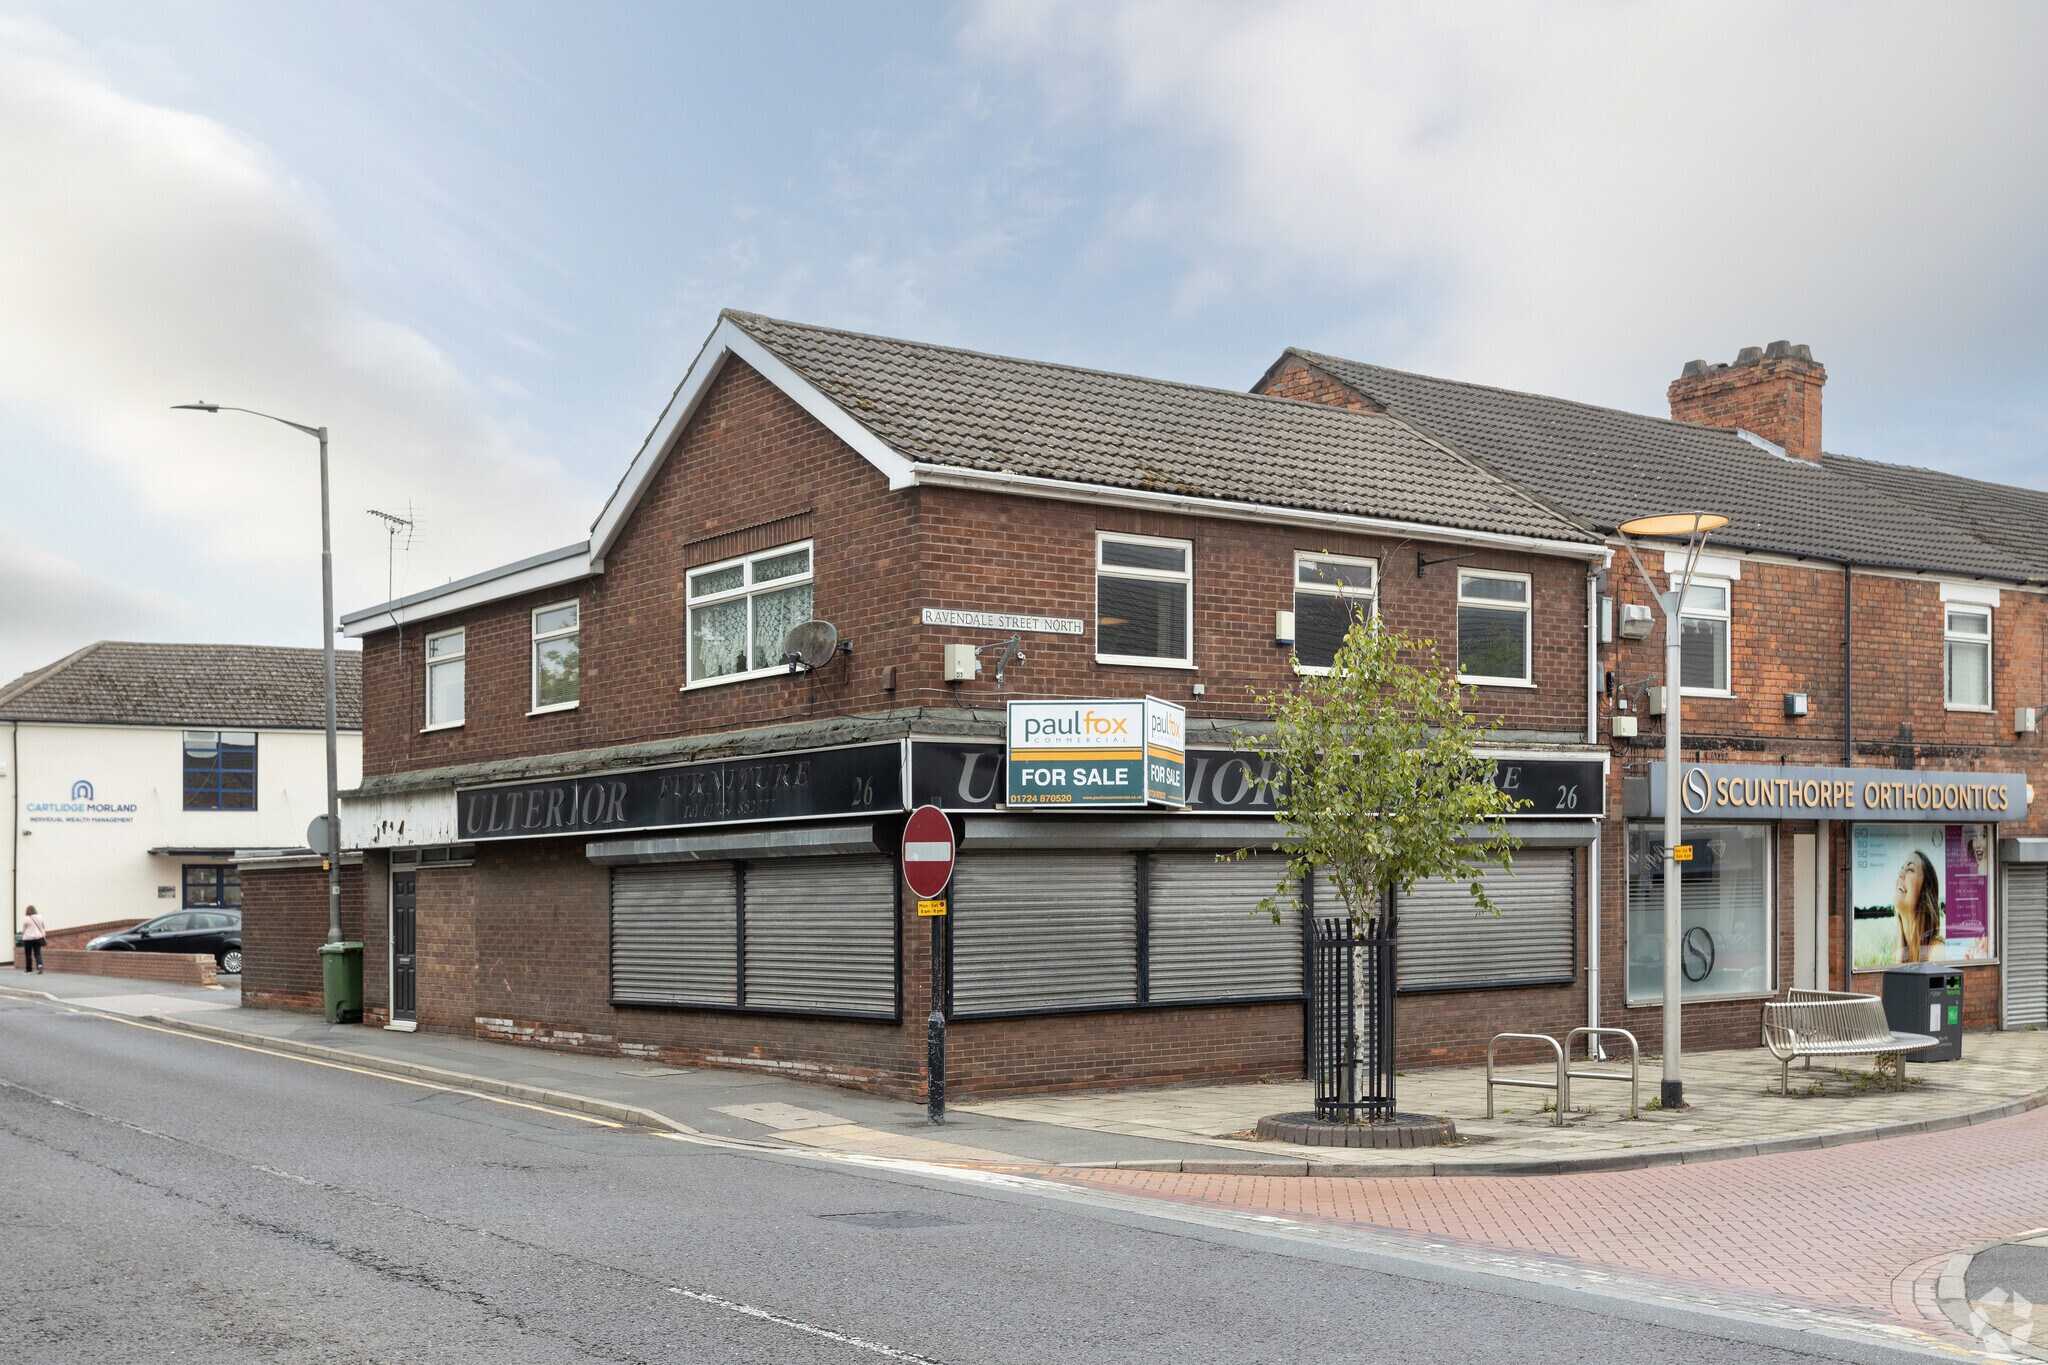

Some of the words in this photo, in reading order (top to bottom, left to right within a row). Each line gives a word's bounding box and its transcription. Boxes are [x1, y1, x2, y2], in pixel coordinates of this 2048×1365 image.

[925, 610, 994, 627] RAVENDALE
[998, 616, 1040, 630] STREET
[1044, 618, 1082, 633] NORTH
[1022, 768, 1066, 786] FOR
[1072, 768, 1129, 786] SALE
[1150, 764, 1165, 784] FOR
[1165, 767, 1181, 787] SALE
[850, 776, 874, 806] 26
[1010, 795, 1038, 803] 01724
[1040, 794, 1072, 802] 870520
[1555, 784, 1578, 809] 26
[1716, 777, 1855, 808] SCUNTHORPE
[1864, 781, 2009, 811] ORTHODONTICS
[26, 803, 85, 812] CARTLIDGE
[87, 804, 137, 812] MORLAND
[466, 781, 628, 834] ULTERIOR
